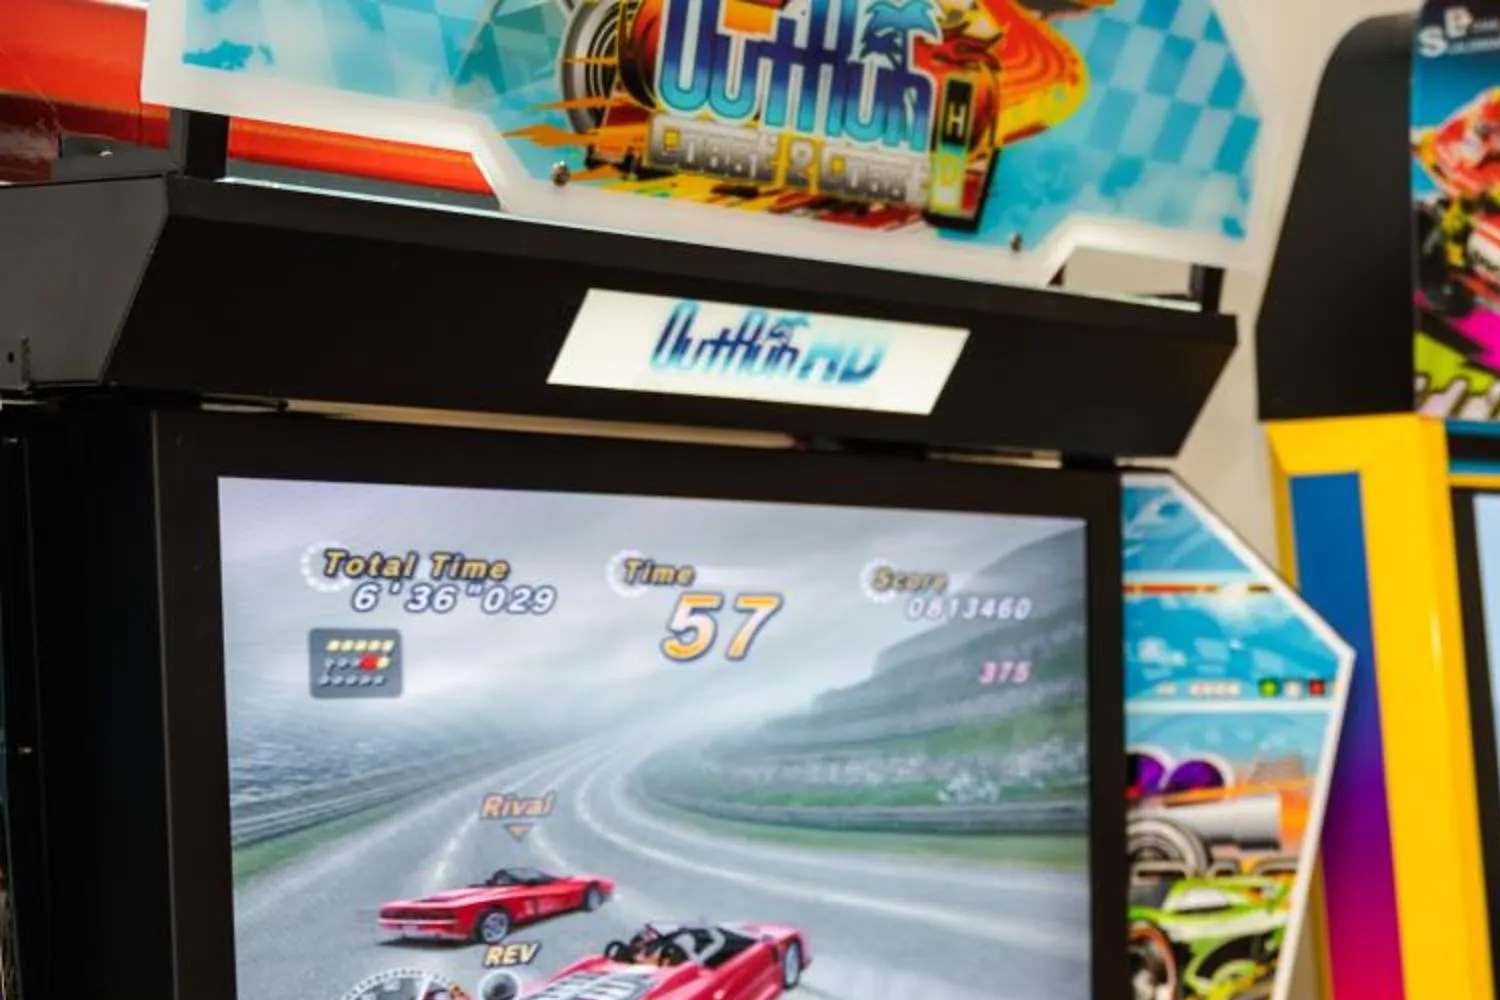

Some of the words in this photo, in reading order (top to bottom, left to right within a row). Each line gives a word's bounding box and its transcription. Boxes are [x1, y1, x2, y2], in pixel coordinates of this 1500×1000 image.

[323, 548, 419, 580] Total
[431, 550, 510, 581] Time
[622, 557, 696, 587] Time
[661, 592, 784, 662] 57
[481, 791, 556, 819] Rival
[485, 943, 540, 967] REV
